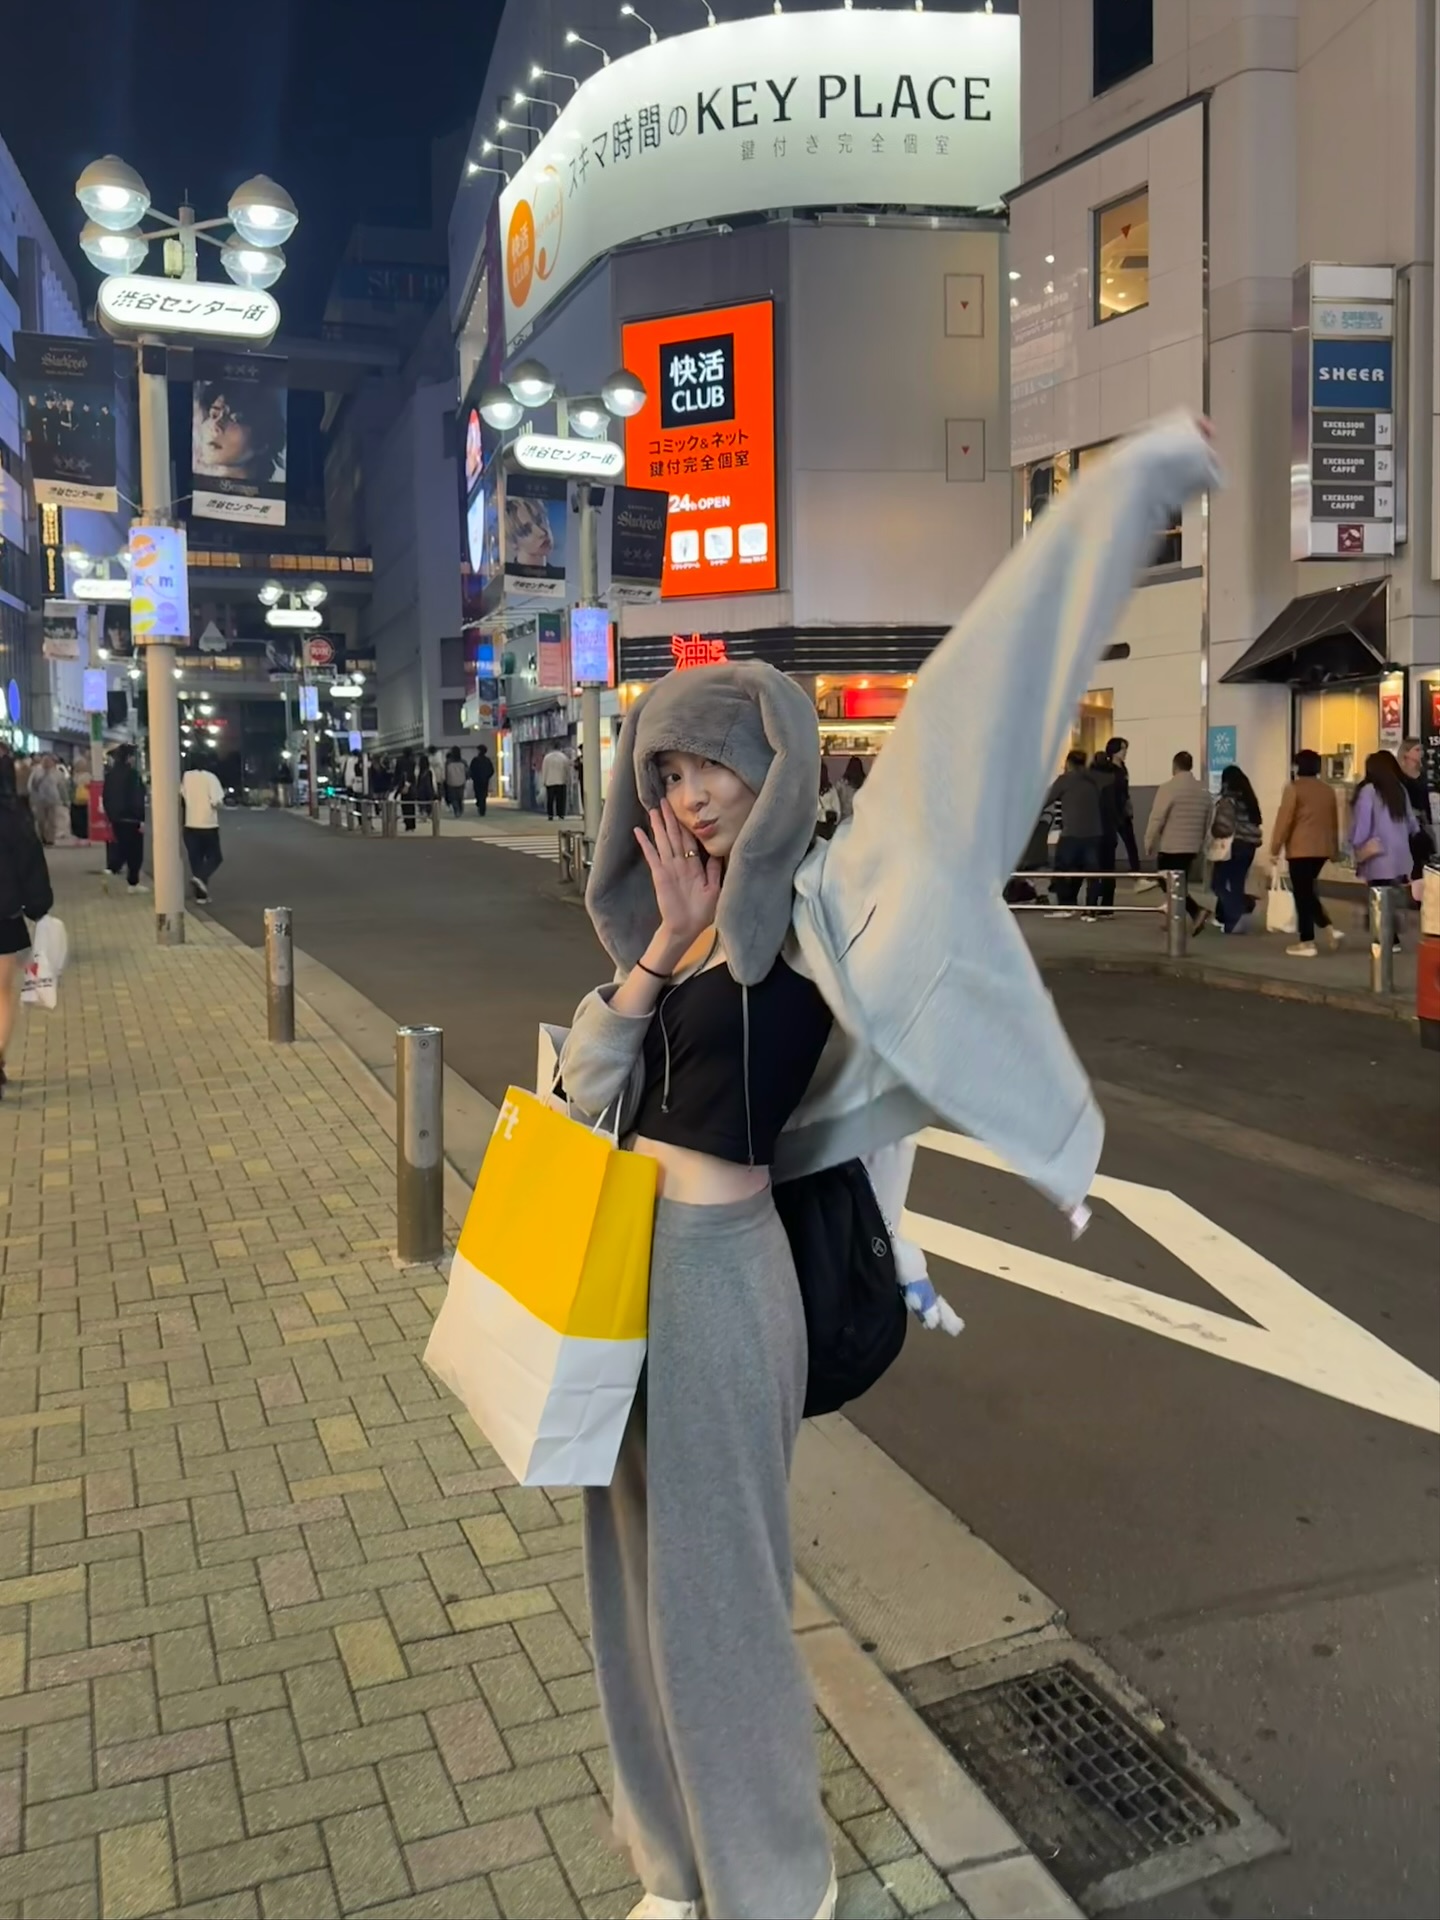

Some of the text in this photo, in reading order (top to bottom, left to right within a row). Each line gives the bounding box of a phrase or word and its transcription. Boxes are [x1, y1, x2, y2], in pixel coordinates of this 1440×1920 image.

[569, 75, 991, 198] スキマ時間の KEY PLACE
[741, 133, 950, 161] 鍵付き完全個室
[111, 290, 269, 322] 渋谷センター街
[669, 349, 725, 387] 快活
[1319, 366, 1385, 382] SHEER
[671, 386, 725, 413] CLUB
[1322, 421, 1365, 429] EXCELSIOR
[650, 450, 749, 477] 鍵付完全個室
[1322, 458, 1365, 466] EXCELSIOR
[698, 495, 731, 510] OPEN
[1322, 494, 1364, 502] EXCELSIOR
